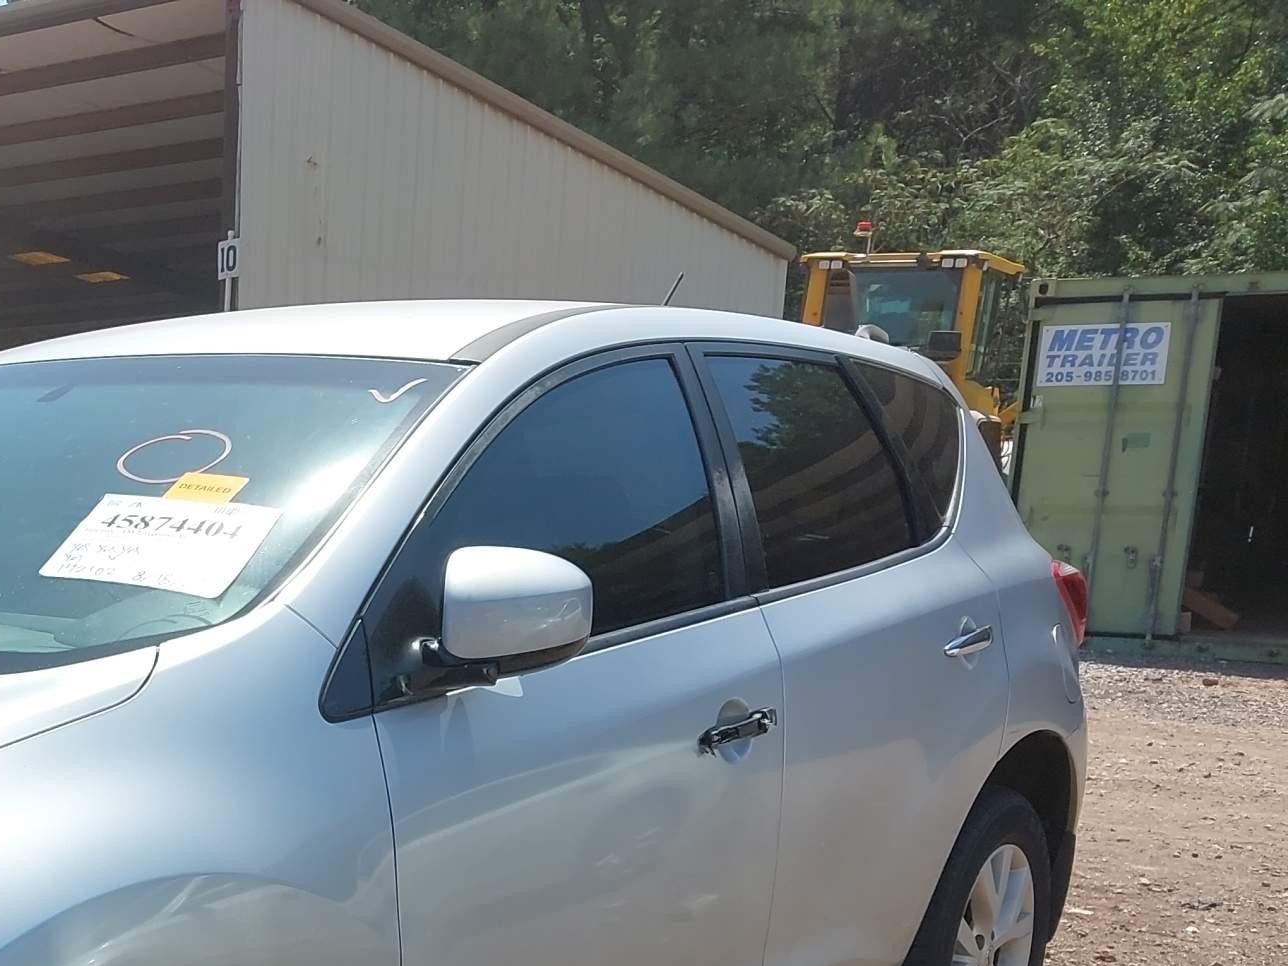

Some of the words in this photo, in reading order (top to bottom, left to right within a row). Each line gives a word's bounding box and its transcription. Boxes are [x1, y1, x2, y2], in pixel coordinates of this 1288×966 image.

[221, 245, 237, 272] 10
[1048, 327, 1165, 352] METRO
[1046, 352, 1159, 368] TRAILER
[1045, 370, 1157, 383] 205-9858701
[178, 482, 232, 494] DETAILED
[100, 513, 243, 540] 45874404
